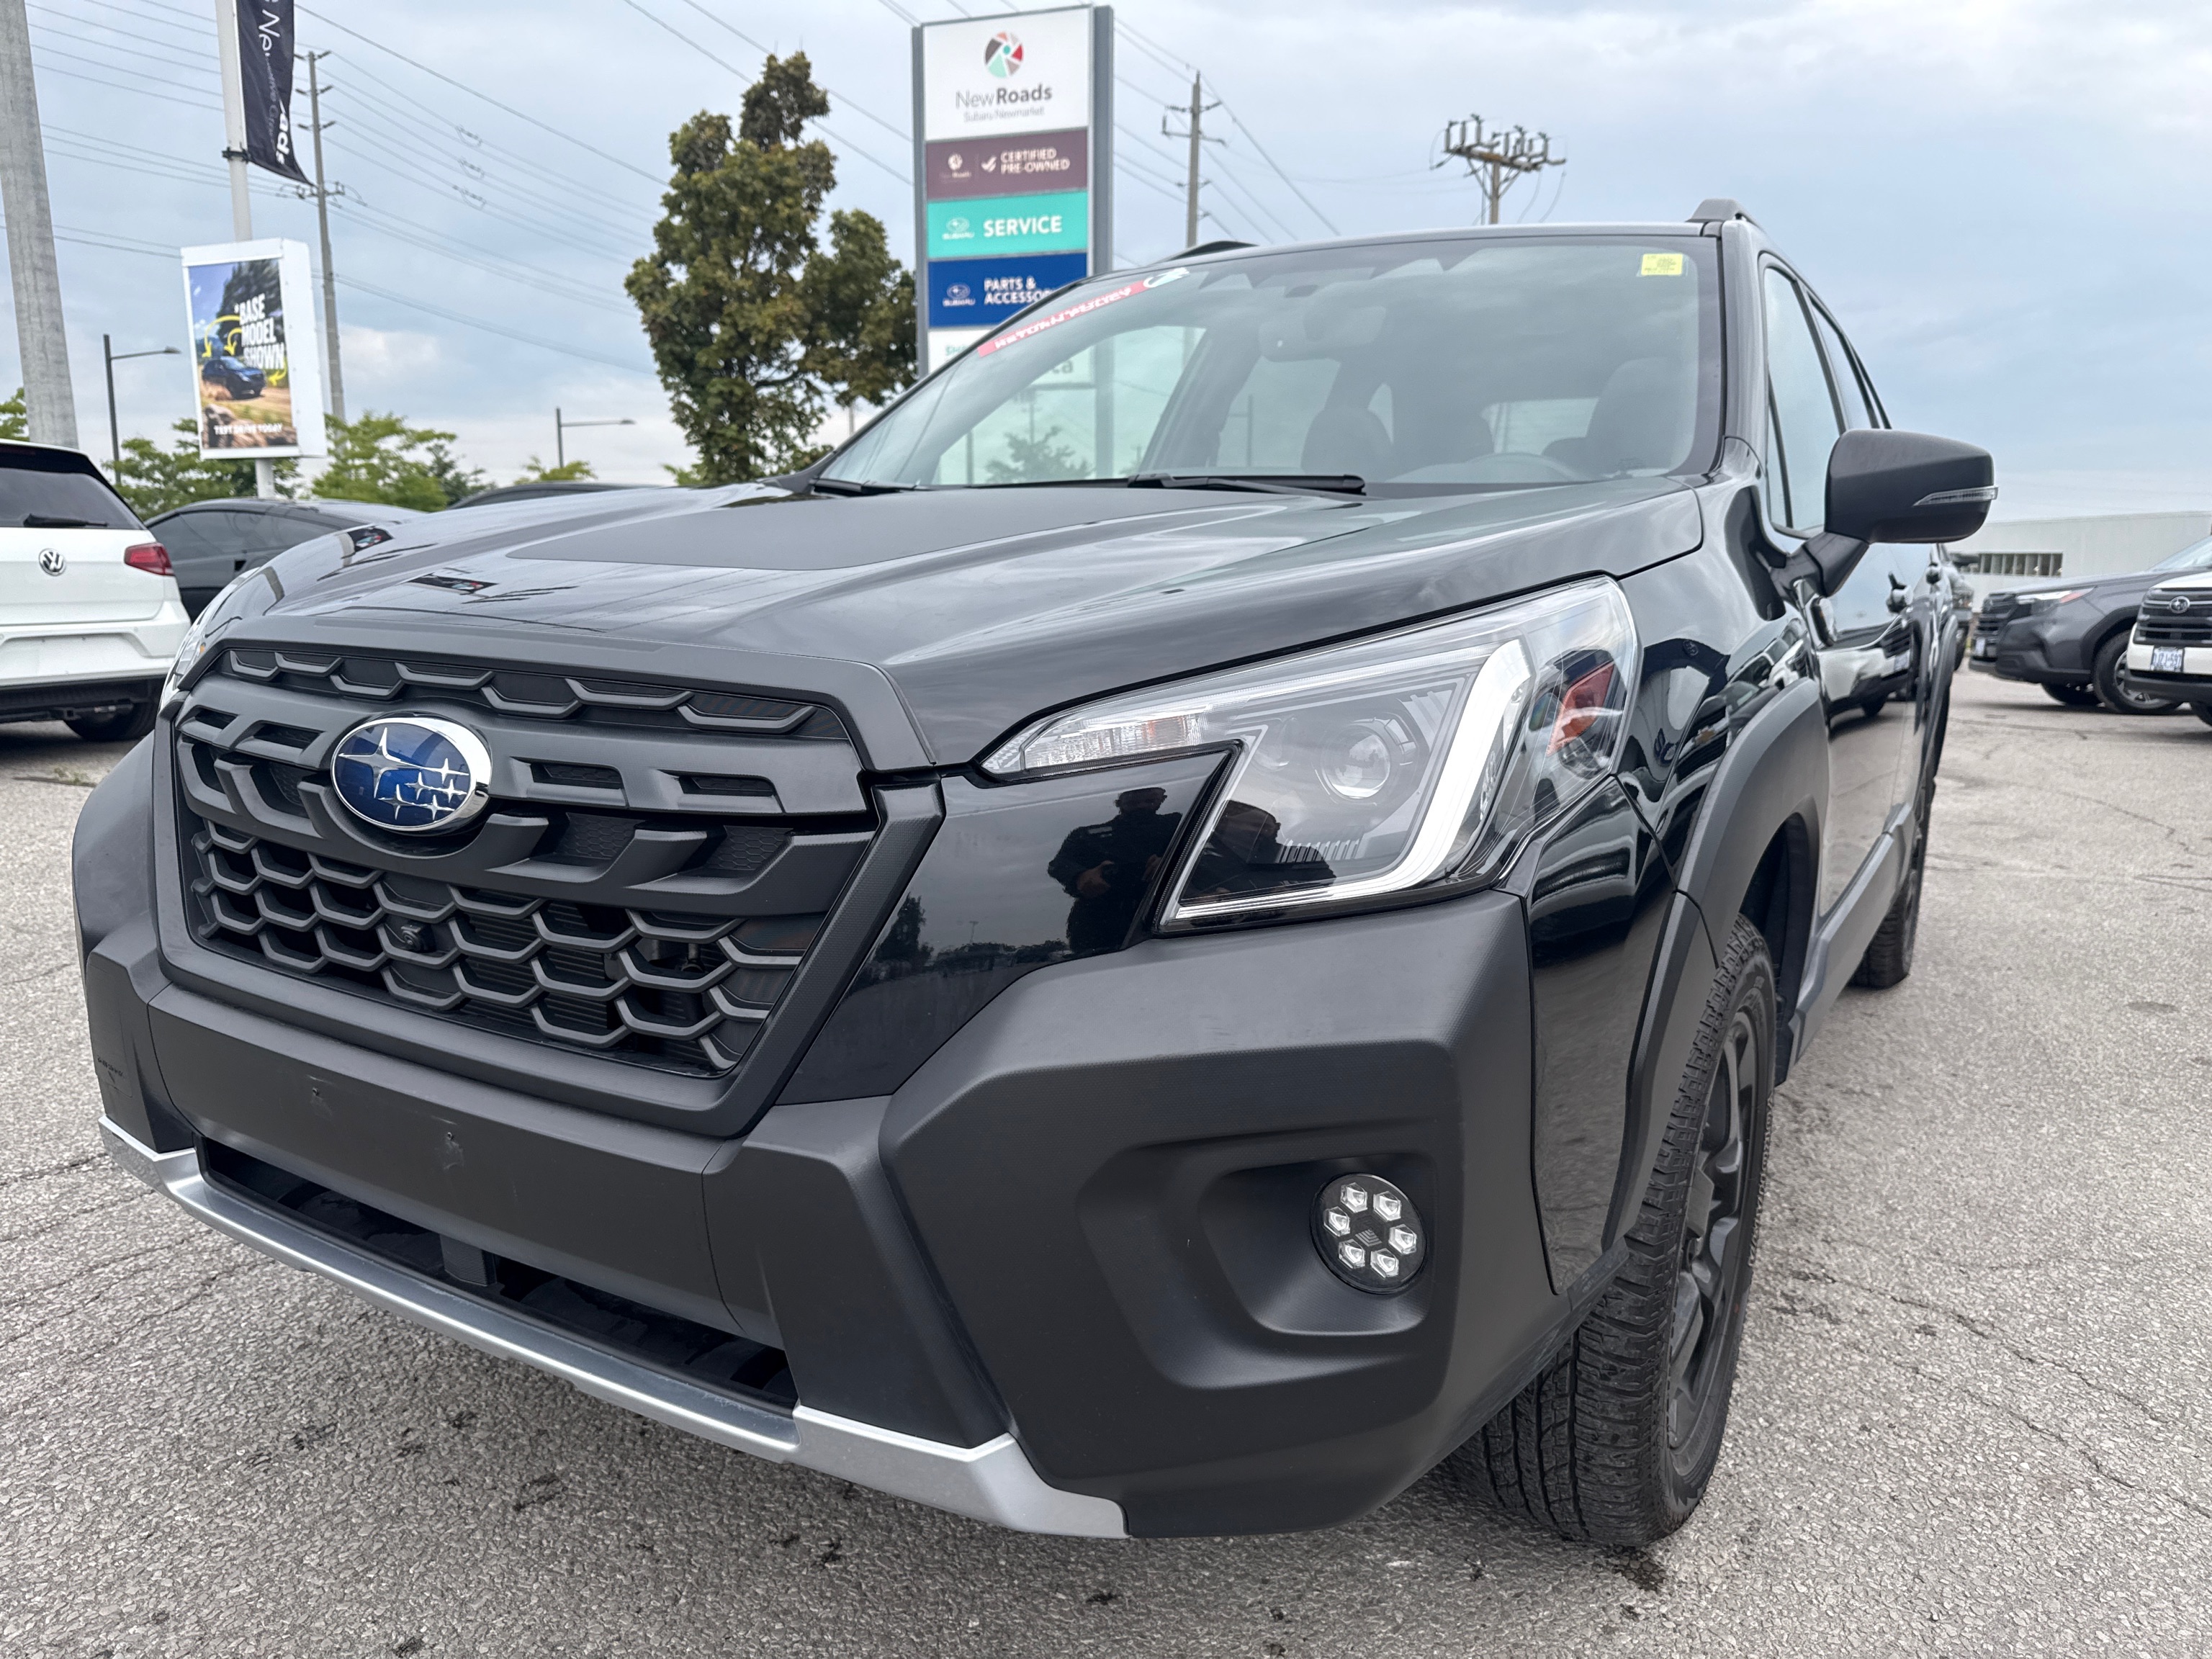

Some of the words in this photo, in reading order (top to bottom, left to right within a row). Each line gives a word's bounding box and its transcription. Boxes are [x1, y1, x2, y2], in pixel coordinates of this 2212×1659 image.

[956, 83, 1052, 109] NewRoads
[1000, 148, 1057, 163] CERTIFIED
[1000, 158, 1071, 174] PRE-OWNED
[983, 215, 1062, 238] SERVICE
[984, 276, 1023, 292] PARTS
[1025, 275, 1036, 290] &
[241, 317, 276, 347] MODEL
[243, 342, 284, 369] SHOWN
